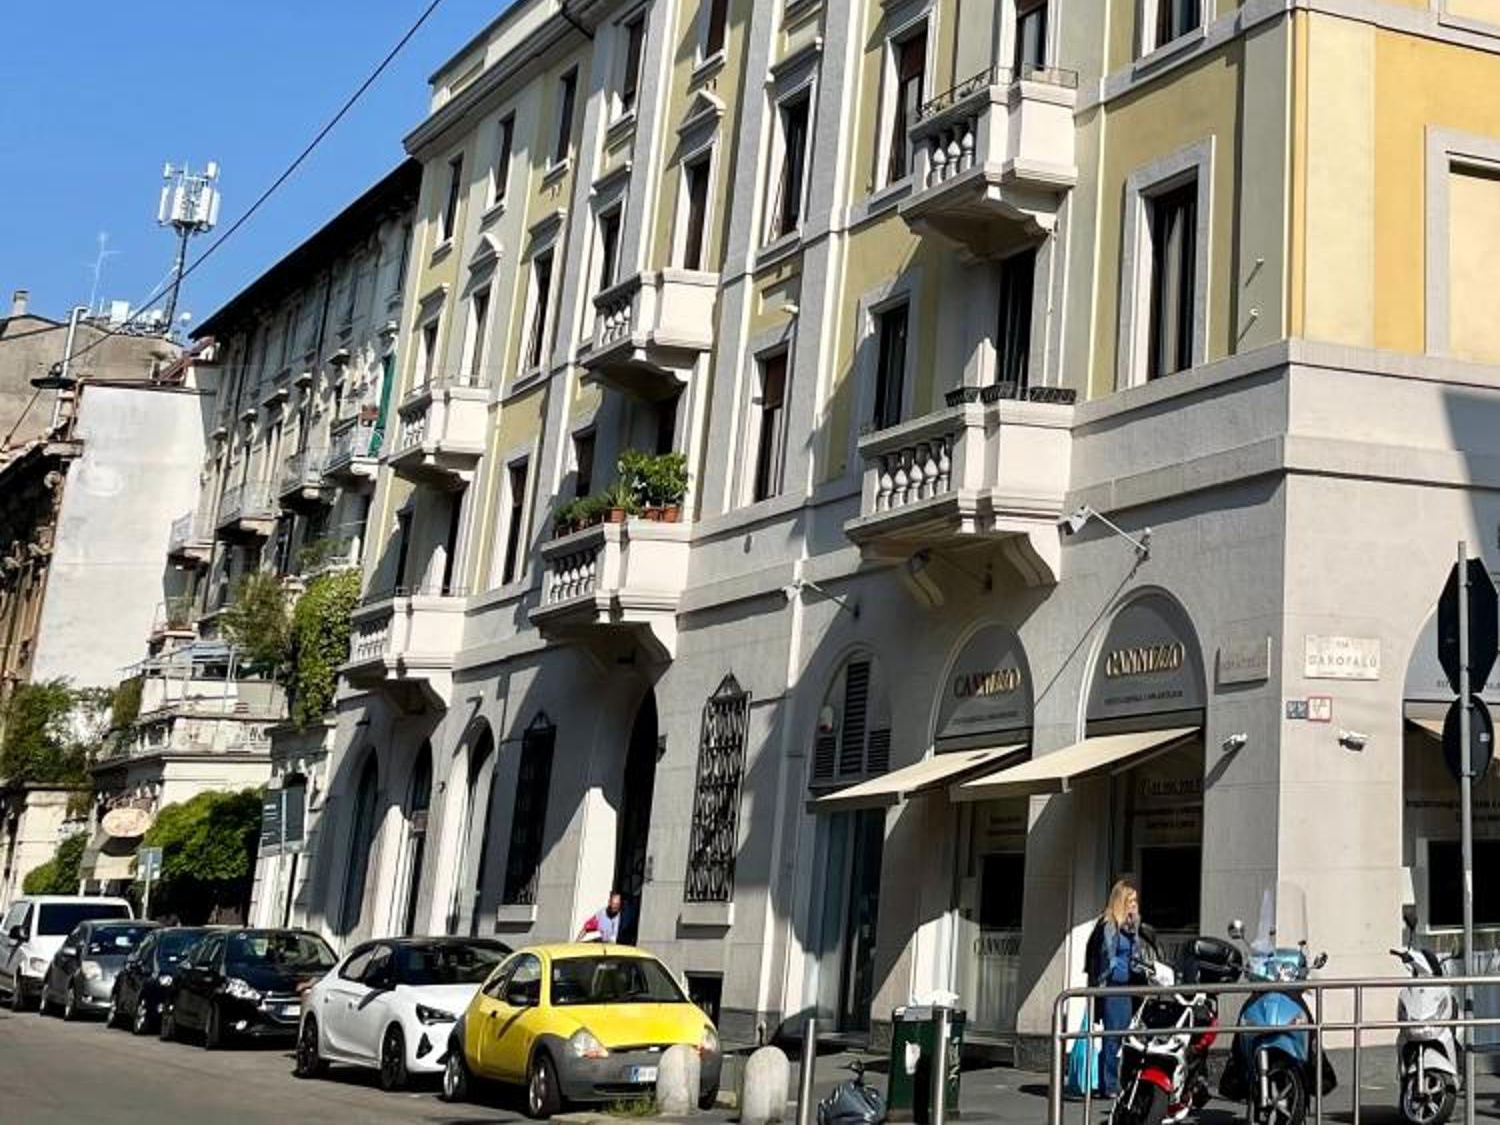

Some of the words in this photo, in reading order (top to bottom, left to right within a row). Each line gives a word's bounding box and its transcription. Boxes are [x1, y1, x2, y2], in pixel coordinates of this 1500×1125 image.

[1105, 641, 1185, 679] CANNIZZO
[1308, 654, 1377, 668] GAROFALO
[953, 666, 1023, 699] CANNIZZO
